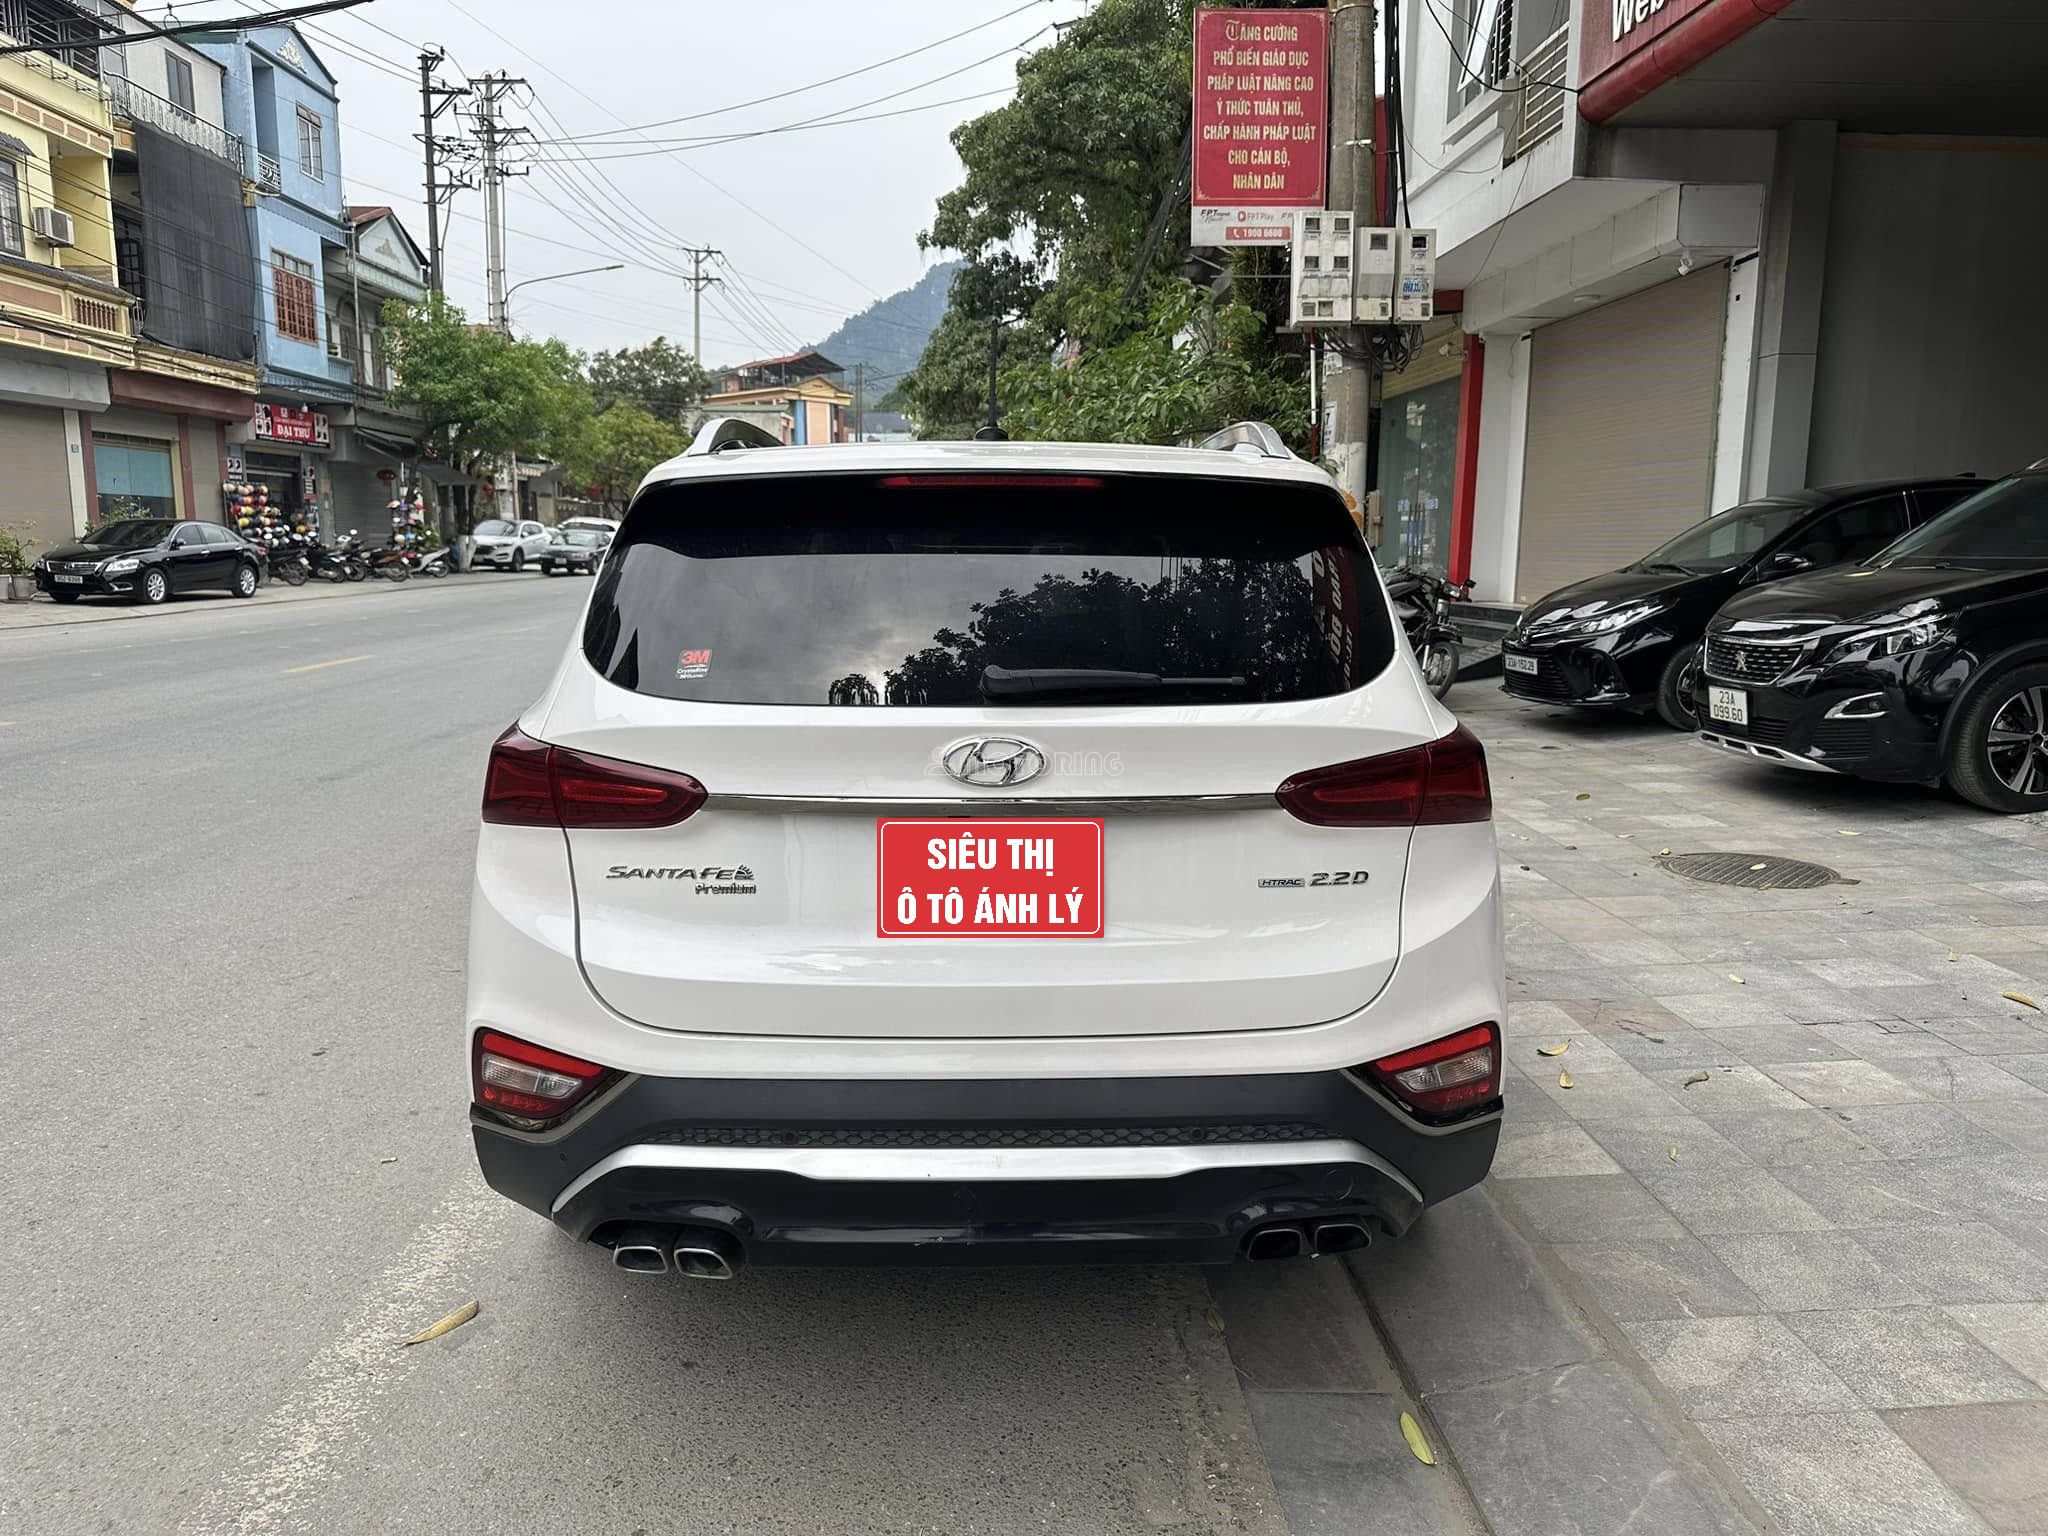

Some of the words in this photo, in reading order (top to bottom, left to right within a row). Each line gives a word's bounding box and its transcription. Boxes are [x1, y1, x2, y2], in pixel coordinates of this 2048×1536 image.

[1263, 23, 1298, 41] CƯỜNG
[1213, 45, 1235, 66] PHỔ
[1236, 46, 1260, 66] BIẾN
[1262, 48, 1287, 66] GIÁO
[1289, 51, 1309, 69] DỤC
[1207, 73, 1235, 91] PHÁP
[1236, 73, 1262, 94] LUẬT
[1263, 73, 1292, 91] NÂNG
[1294, 76, 1314, 91] CAO
[1217, 97, 1224, 115] Ý
[1225, 98, 1251, 115] THỨC
[1253, 98, 1280, 115] TUÂN
[1282, 96, 1304, 118] THỦ,
[1203, 121, 1231, 140] CHẤP
[1232, 122, 1261, 140] HÀNH
[1262, 122, 1290, 140] PHÁP
[1291, 122, 1317, 144] LUẬT
[1228, 150, 1248, 165] CHO
[1250, 147, 1272, 165] CÁN
[1273, 147, 1291, 168] BỘ,
[1232, 171, 1261, 190] NHÂN
[1263, 171, 1285, 190] DÂN
[681, 650, 711, 665] 3M
[1719, 690, 1736, 706] 23A
[1713, 704, 1743, 722] 099.60
[1309, 871, 1369, 886] 2.2D
[695, 882, 757, 895] Premium
